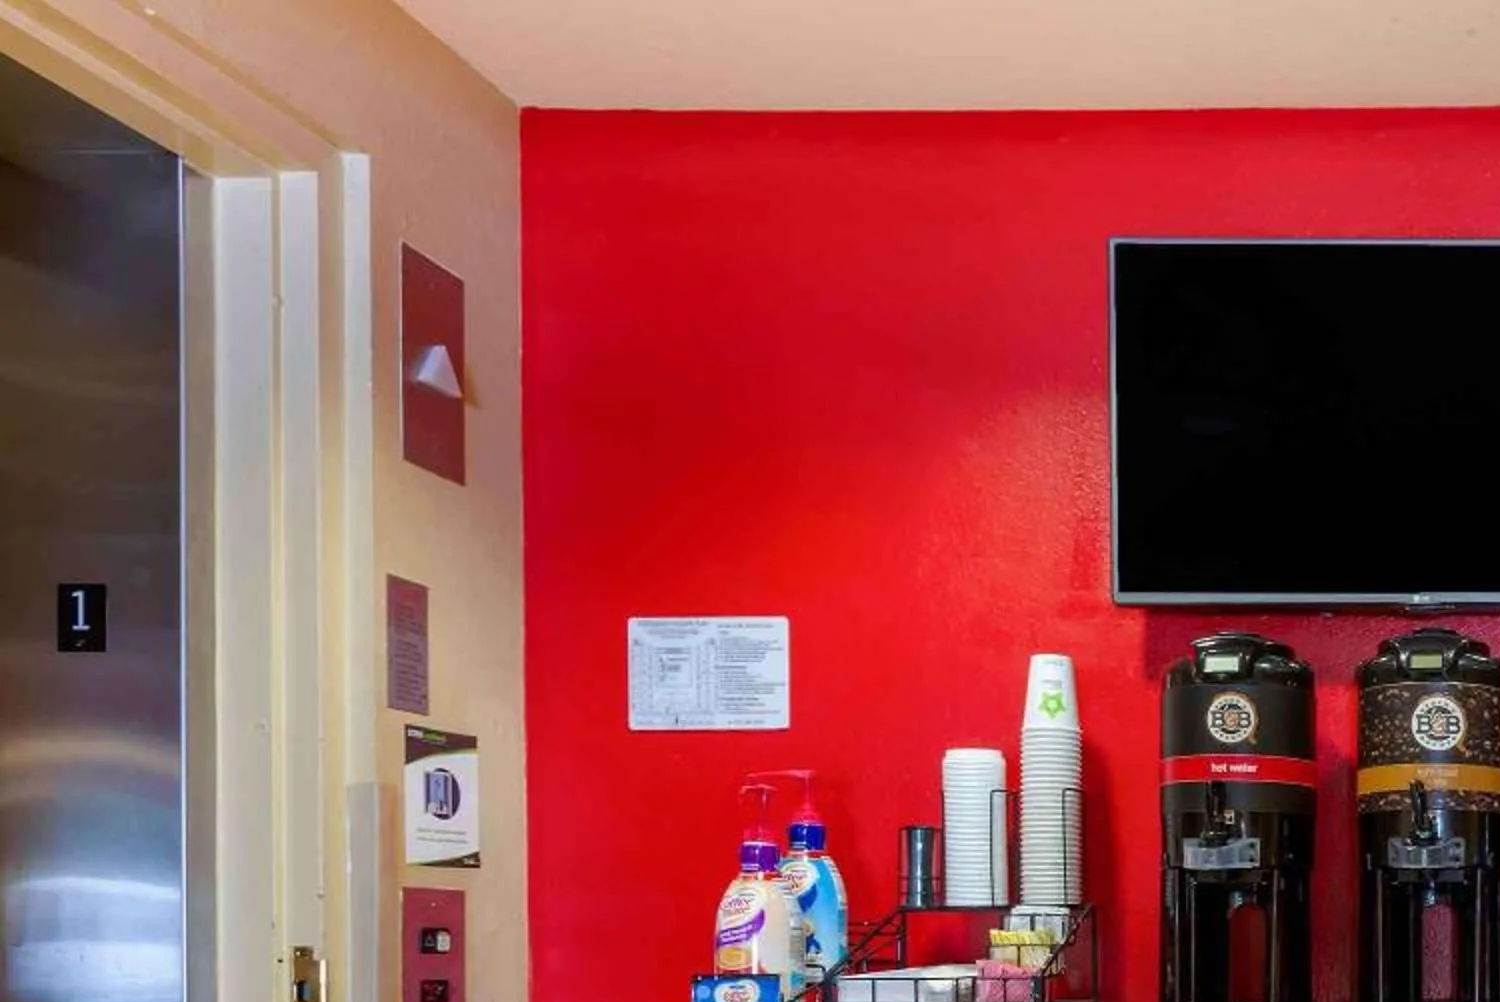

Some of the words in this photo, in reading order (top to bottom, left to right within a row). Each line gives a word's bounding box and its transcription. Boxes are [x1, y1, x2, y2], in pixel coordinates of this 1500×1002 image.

[71, 590, 91, 631] 1
[1210, 763, 1227, 773] hot
[1229, 763, 1259, 773] water
